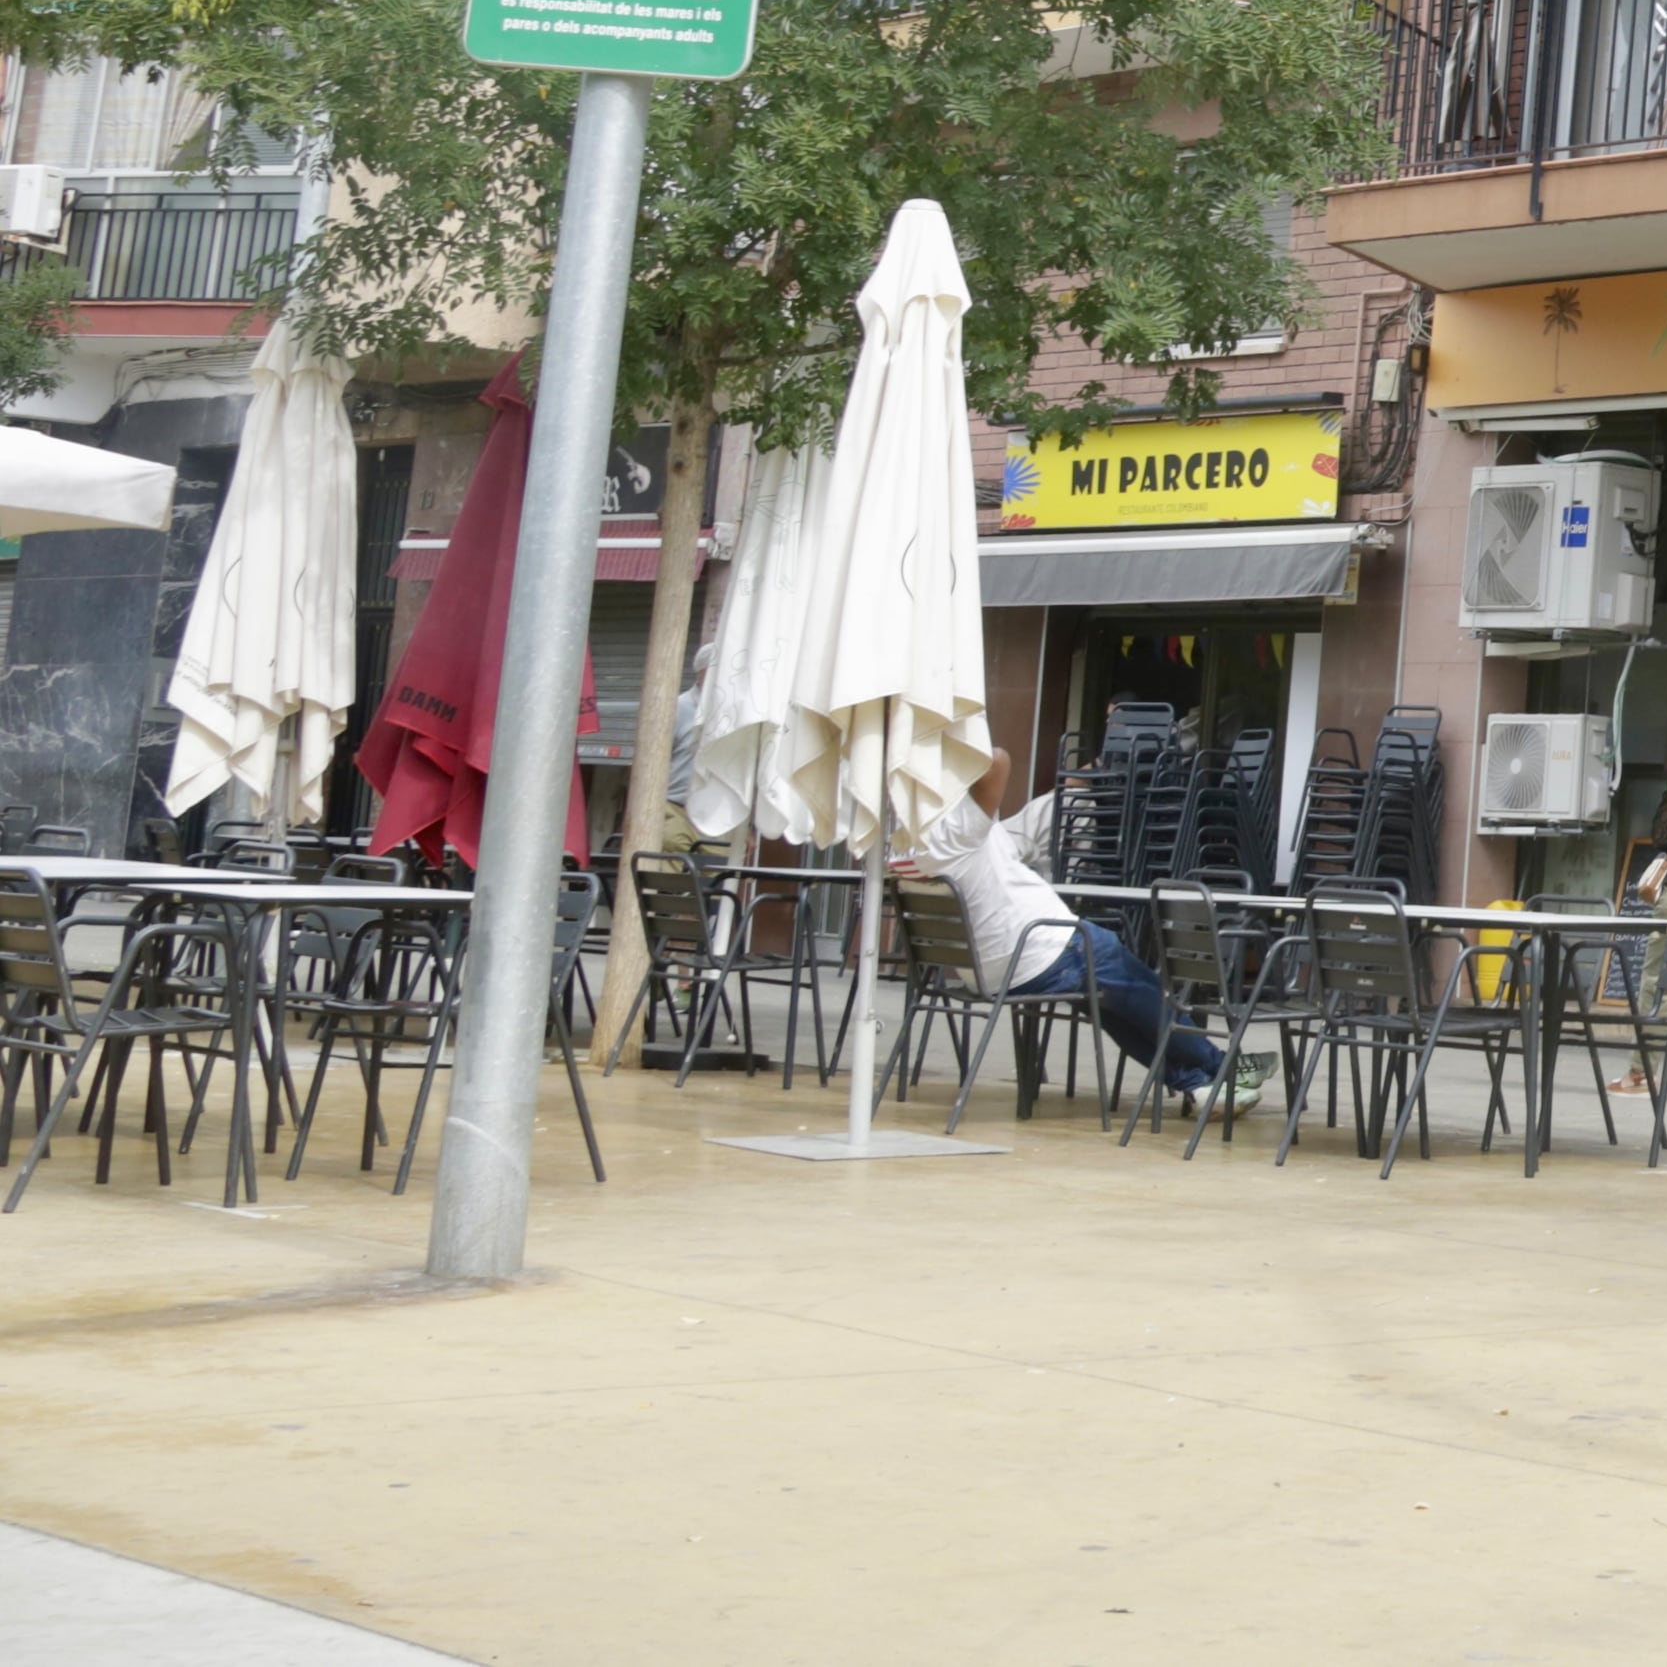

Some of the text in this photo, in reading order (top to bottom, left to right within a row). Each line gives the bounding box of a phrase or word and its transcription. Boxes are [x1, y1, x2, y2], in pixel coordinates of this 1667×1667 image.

[615, 4, 631, 16] de
[634, 4, 652, 17] les
[655, 8, 693, 20] mares
[696, 7, 701, 20] i
[703, 8, 722, 22] els
[502, 17, 714, 43] pares o dels acompanyants adults
[1071, 448, 1270, 496] MI PARCERO
[1562, 521, 1588, 534] Haier
[398, 686, 458, 723] DAMM
